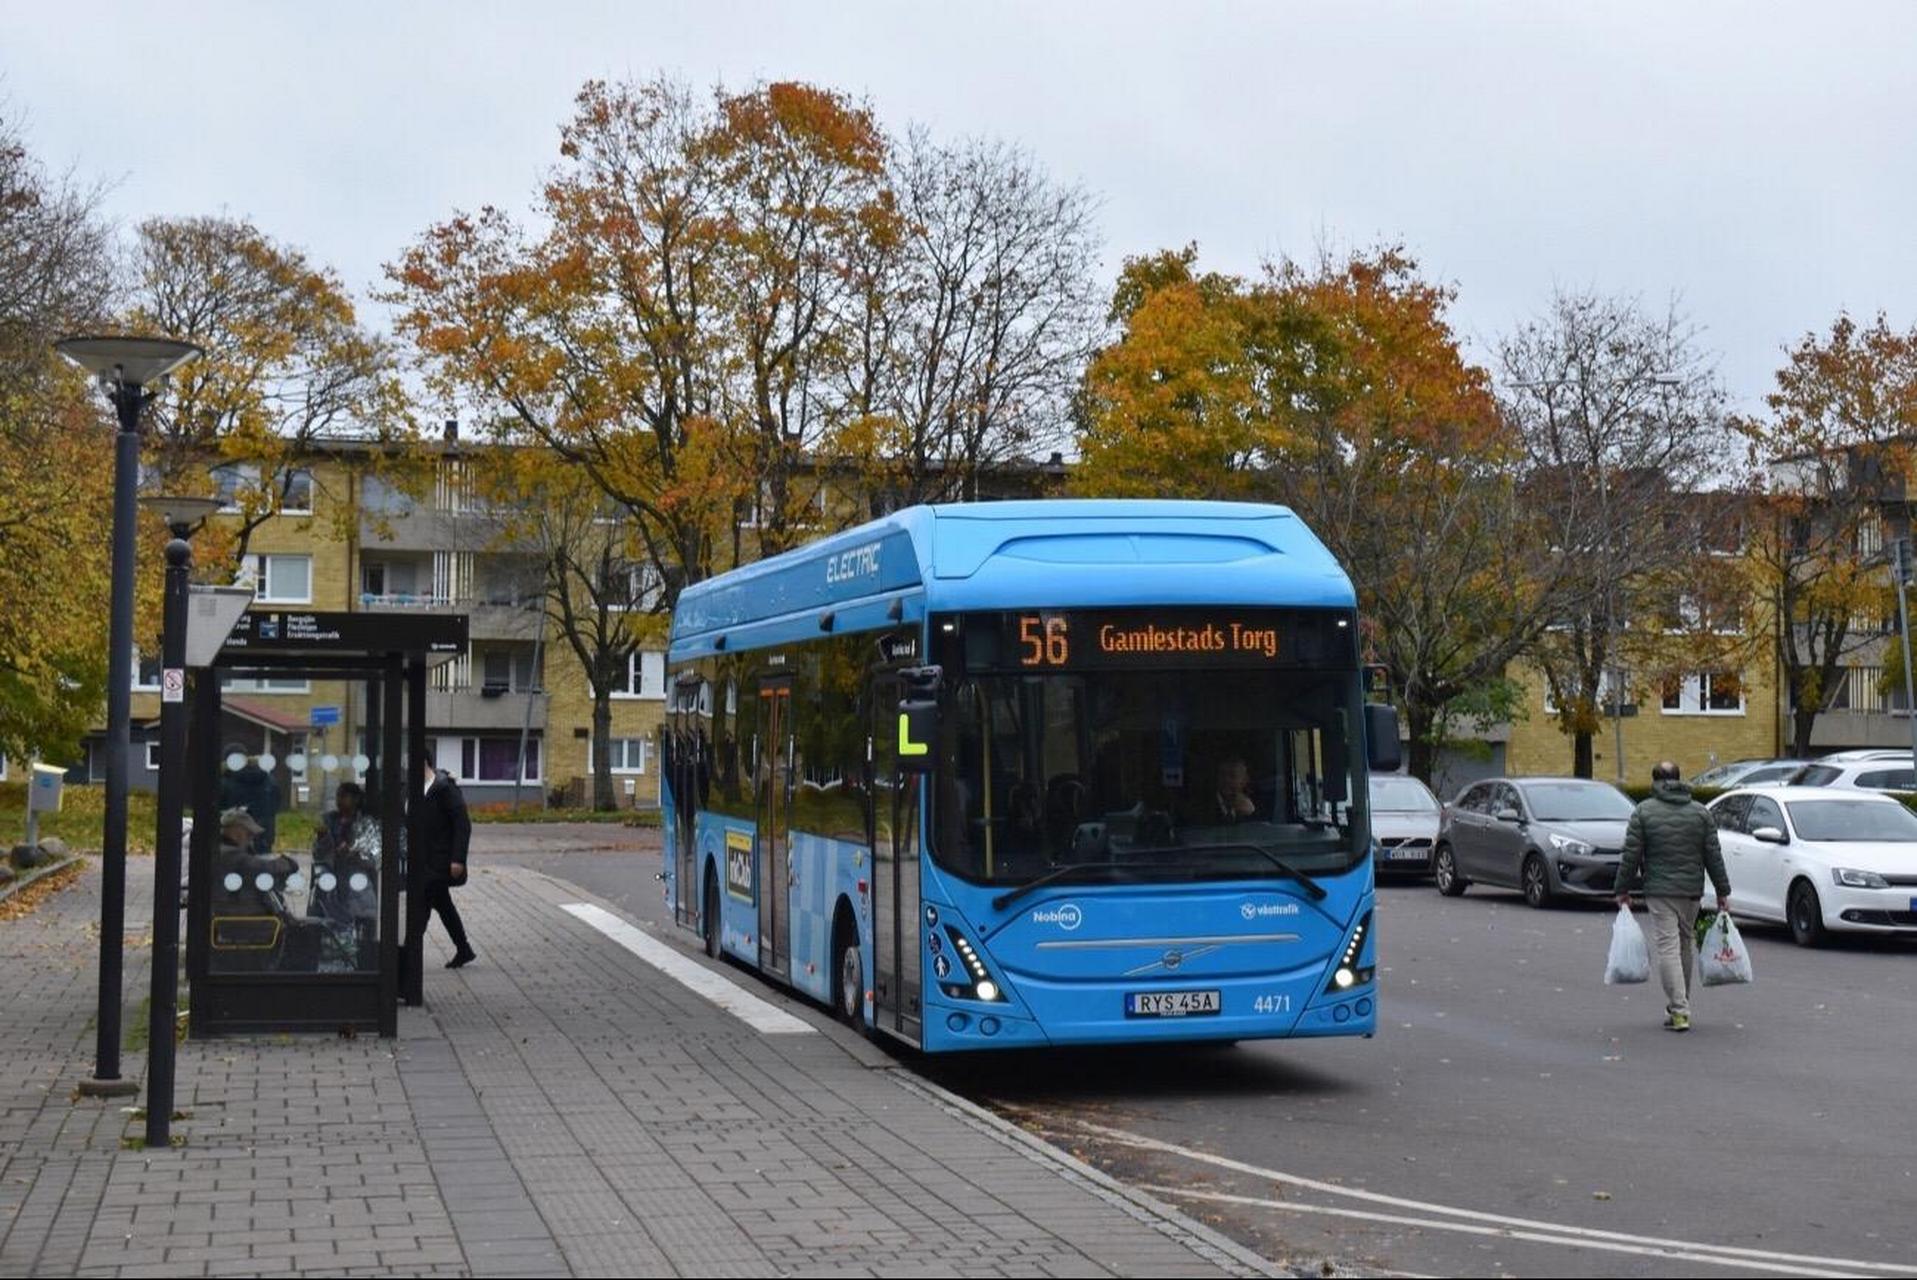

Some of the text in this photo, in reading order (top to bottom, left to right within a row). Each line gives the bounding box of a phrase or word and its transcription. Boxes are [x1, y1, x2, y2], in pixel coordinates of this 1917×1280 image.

[827, 543, 881, 583] ELECTRIC
[1020, 617, 1277, 665] 56 Gamlestads Torg
[1033, 907, 1079, 925] Nobina
[1140, 993, 1213, 1012] RYS 45A
[1254, 995, 1290, 1013] 4471
